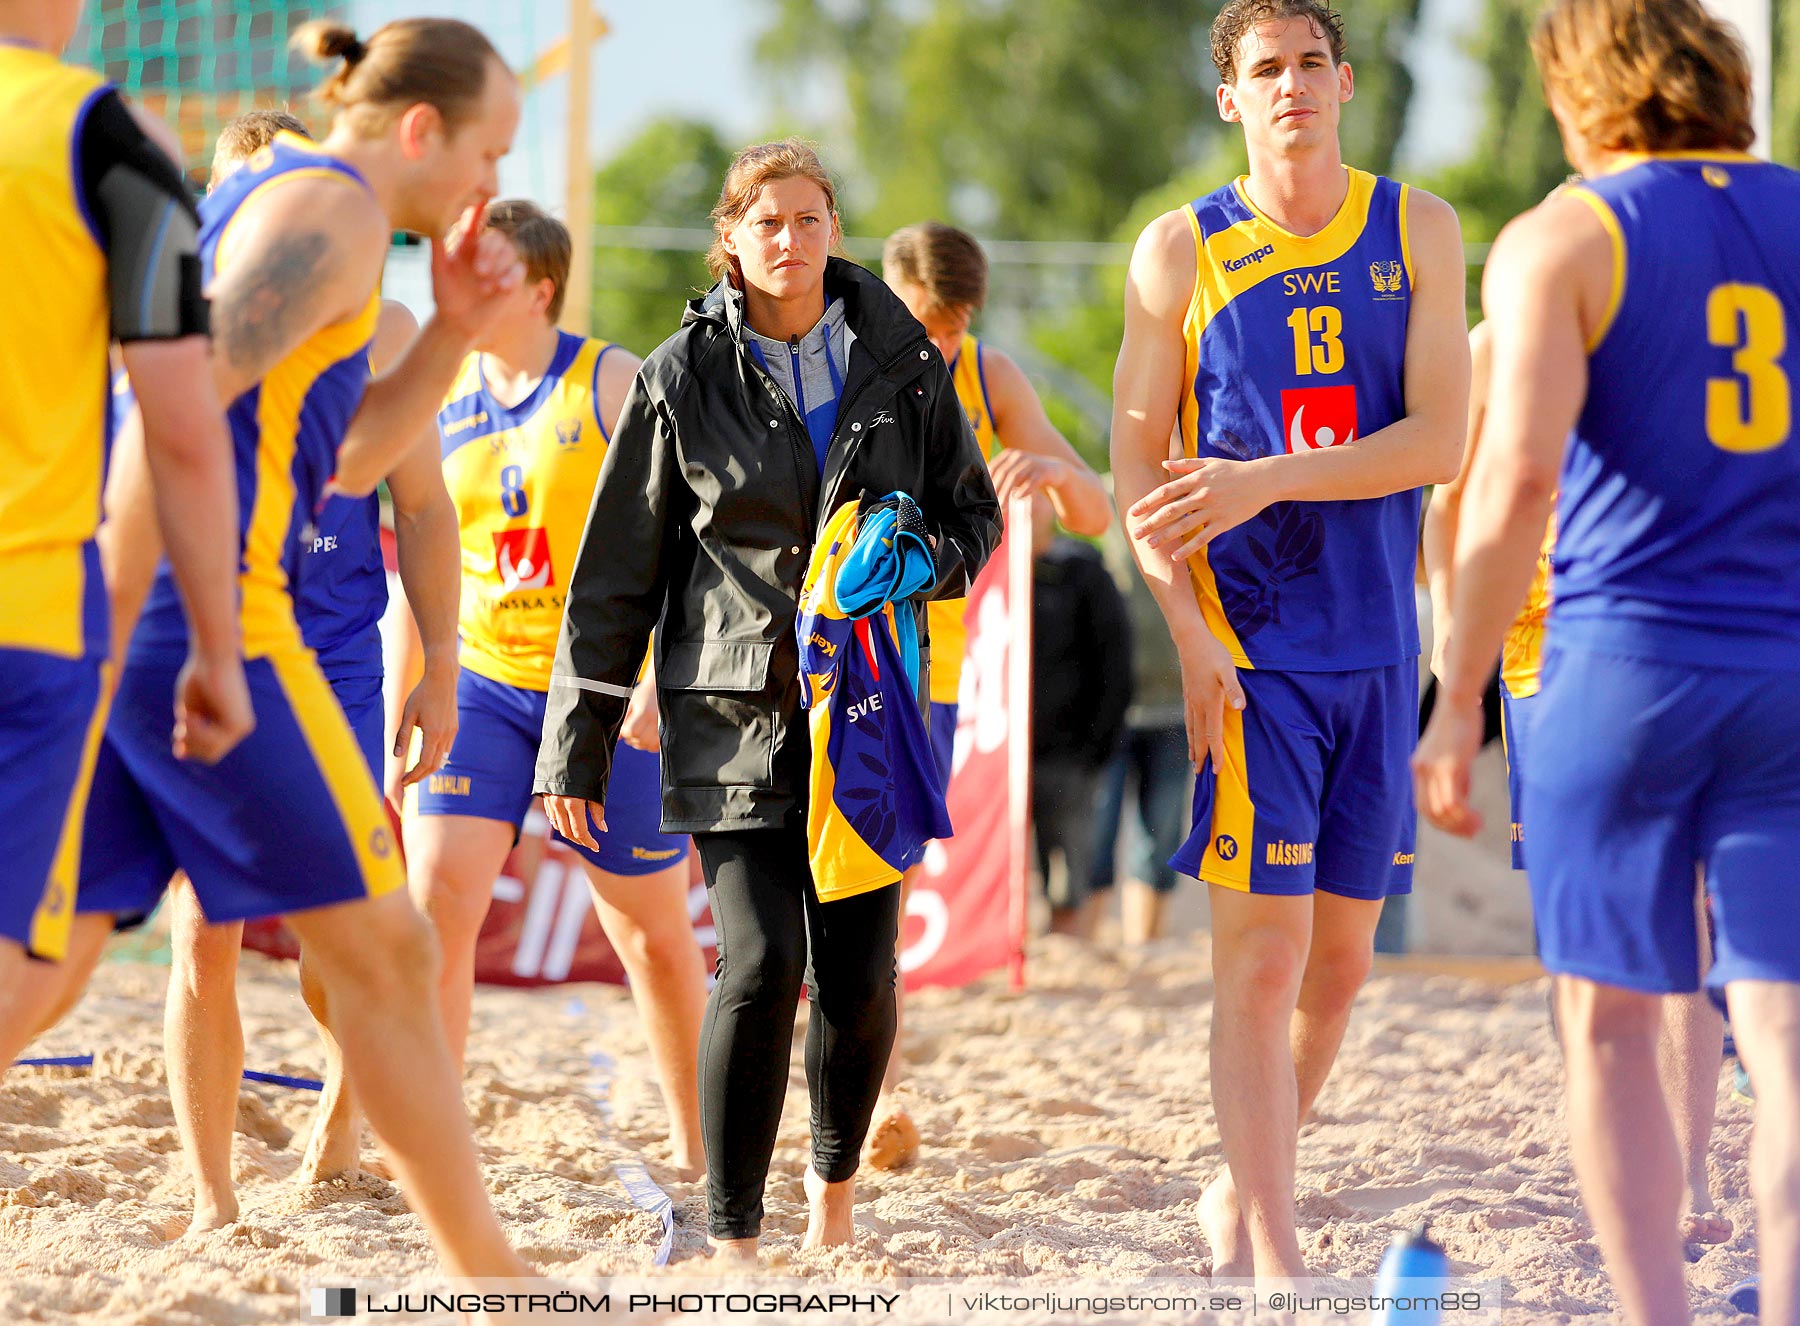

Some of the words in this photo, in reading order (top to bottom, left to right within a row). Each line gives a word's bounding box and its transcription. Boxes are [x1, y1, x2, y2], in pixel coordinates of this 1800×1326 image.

[1222, 243, 1275, 273] Kempa
[1283, 271, 1341, 296] SWE
[1286, 305, 1345, 375] 13
[1705, 280, 1792, 454] 3
[869, 410, 896, 428] Five
[501, 464, 528, 518] 8
[1266, 839, 1314, 866] MÄSSING
